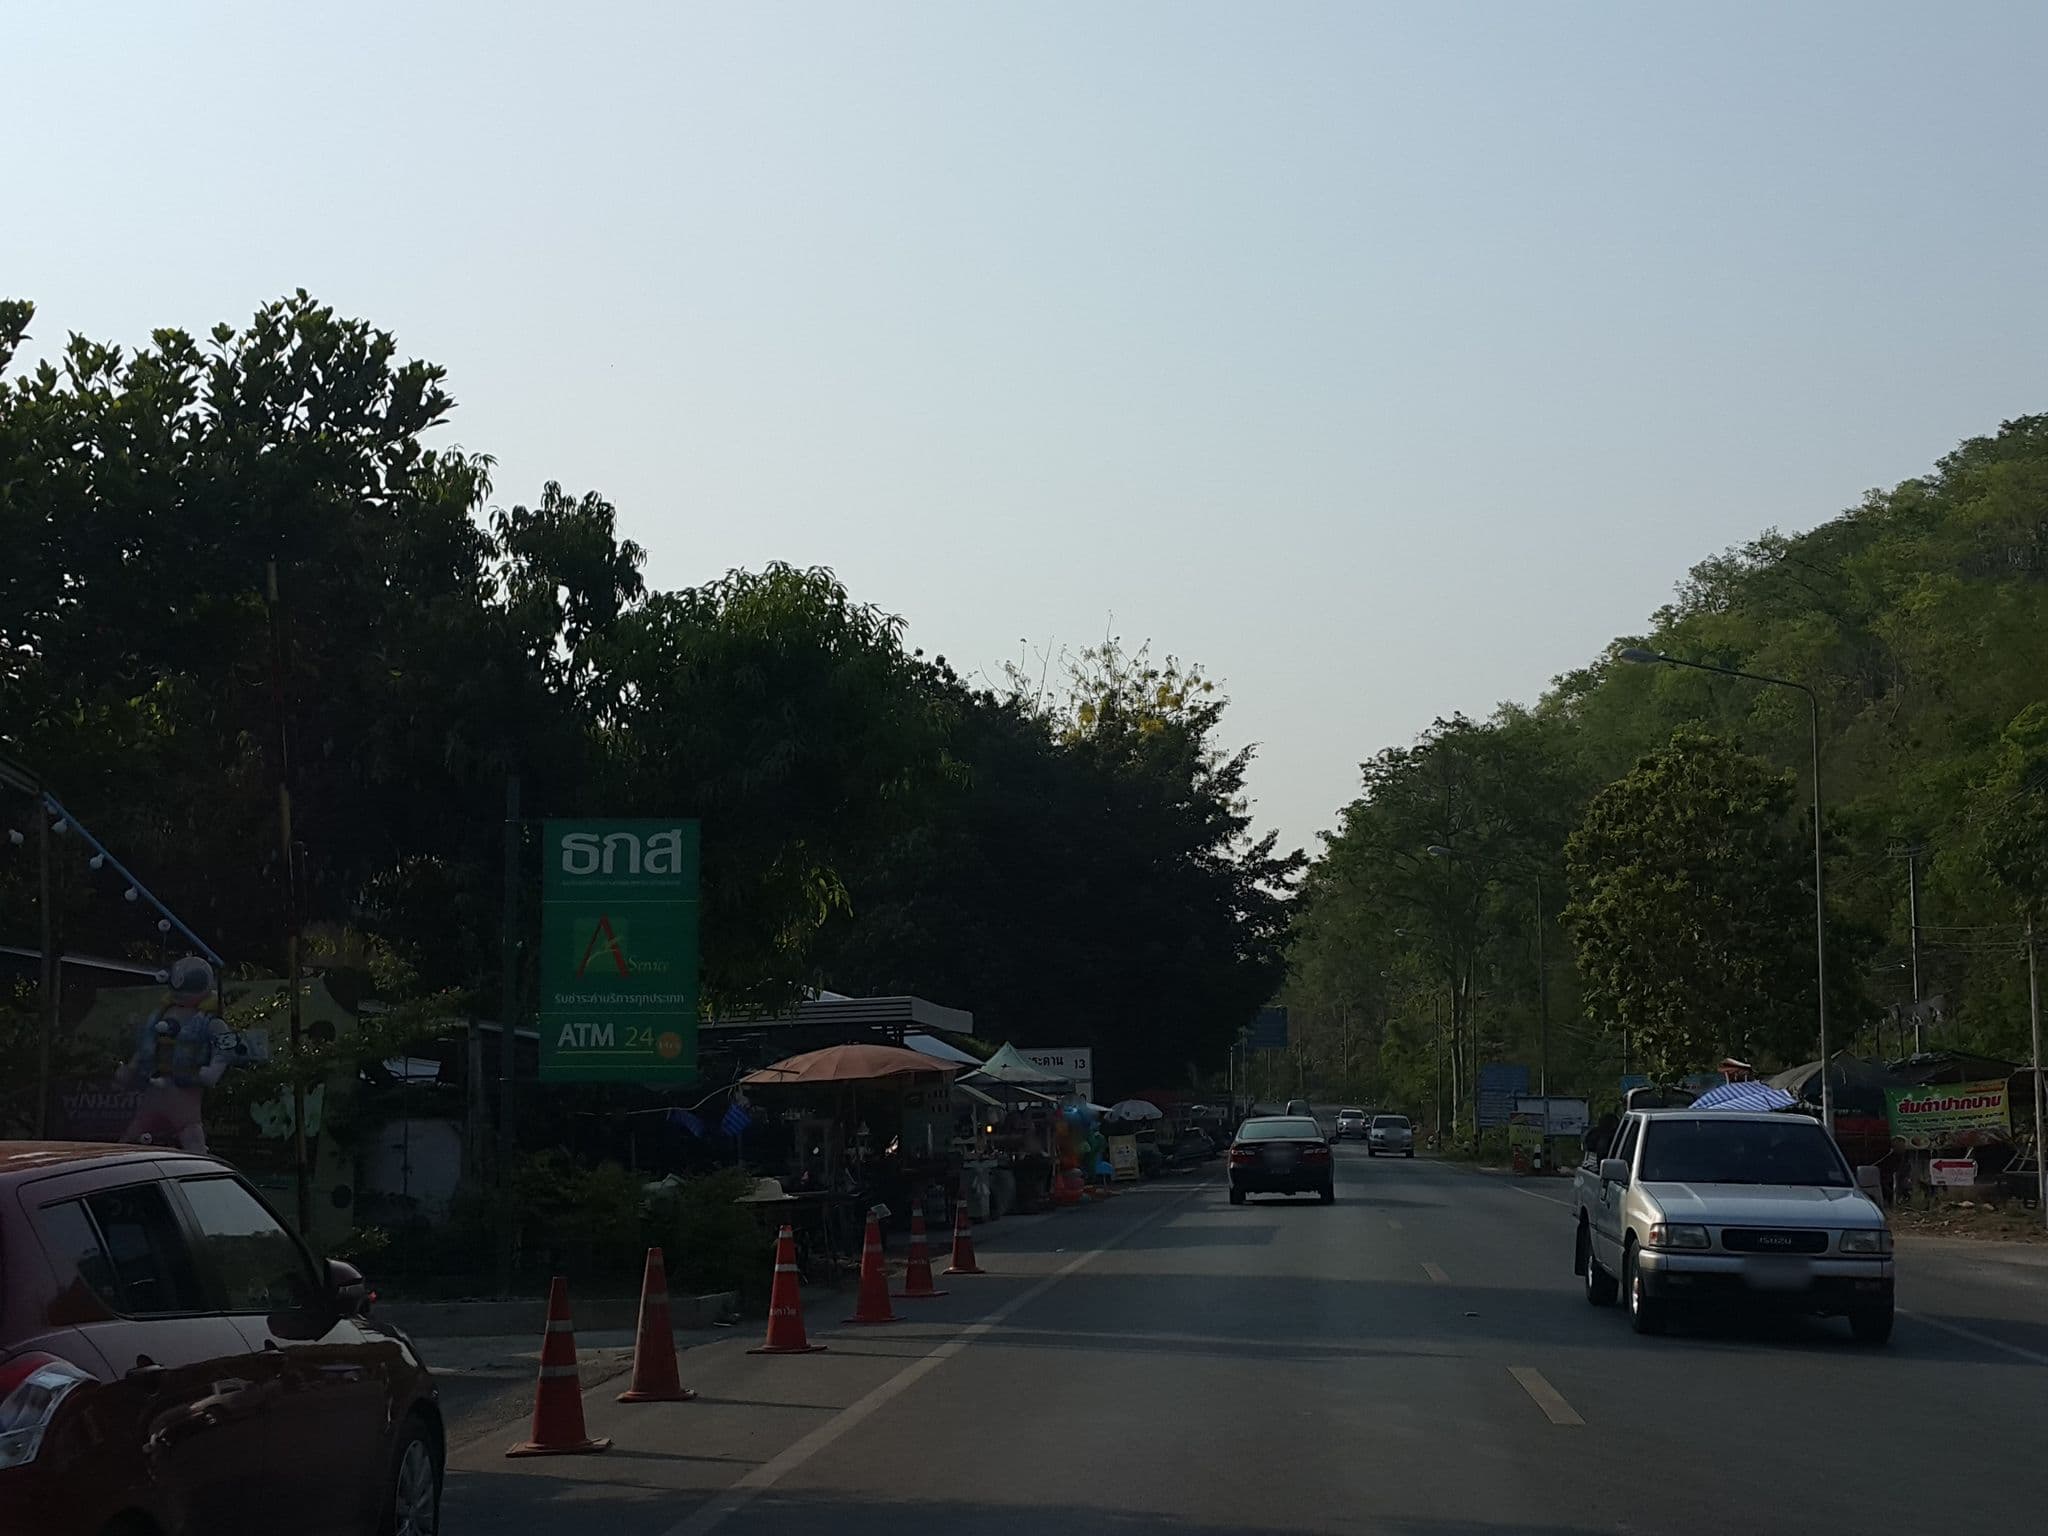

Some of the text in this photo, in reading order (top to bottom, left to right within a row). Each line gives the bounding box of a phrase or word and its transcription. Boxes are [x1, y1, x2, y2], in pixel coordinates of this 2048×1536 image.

[561, 829, 682, 875] ธกส
[557, 1023, 615, 1047] ATM
[625, 1026, 654, 1047] 24
[1074, 1059, 1086, 1069] 13
